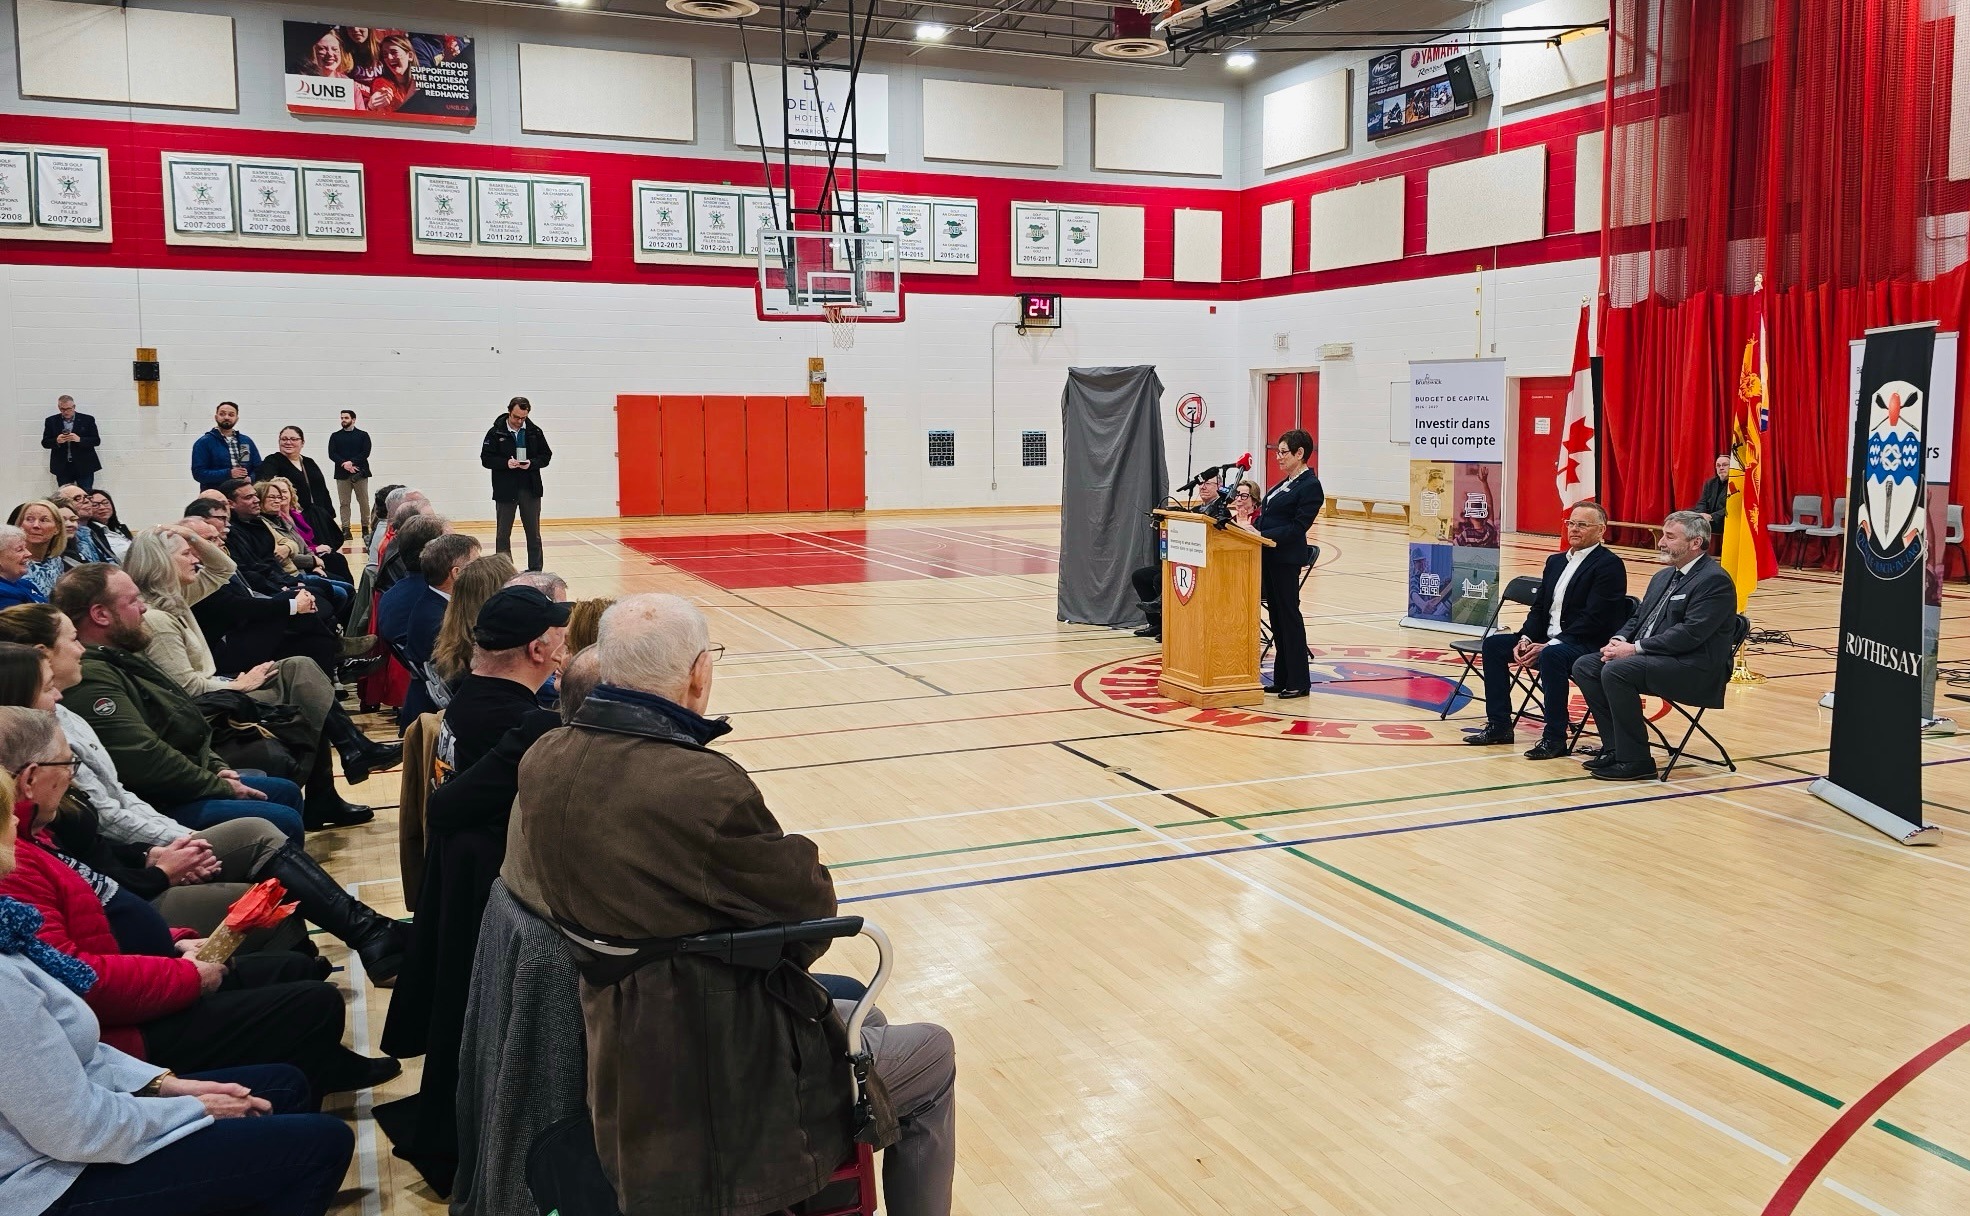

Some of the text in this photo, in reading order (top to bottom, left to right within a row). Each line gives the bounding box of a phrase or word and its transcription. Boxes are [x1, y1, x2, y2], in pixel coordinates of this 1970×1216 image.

[1422, 40, 1459, 64] YAMAHA
[366, 65, 384, 78] UN
[410, 66, 456, 76] SUPPORTER
[429, 75, 469, 84] ROTHESAY
[312, 84, 346, 98] UNB
[437, 84, 469, 92] SCHOOL
[425, 90, 469, 99] REDHAWKS
[795, 114, 829, 123] HOTES
[47, 215, 92, 223] 2007-2008
[249, 224, 290, 232] 2007-2008
[426, 230, 463, 238] 2011-2012
[1029, 298, 1050, 317] 24
[1415, 418, 1490, 429] Investir dans
[1415, 434, 1496, 448] ce qui compte
[1180, 568, 1188, 588] R
[1846, 632, 1923, 677] ROTHESAY
